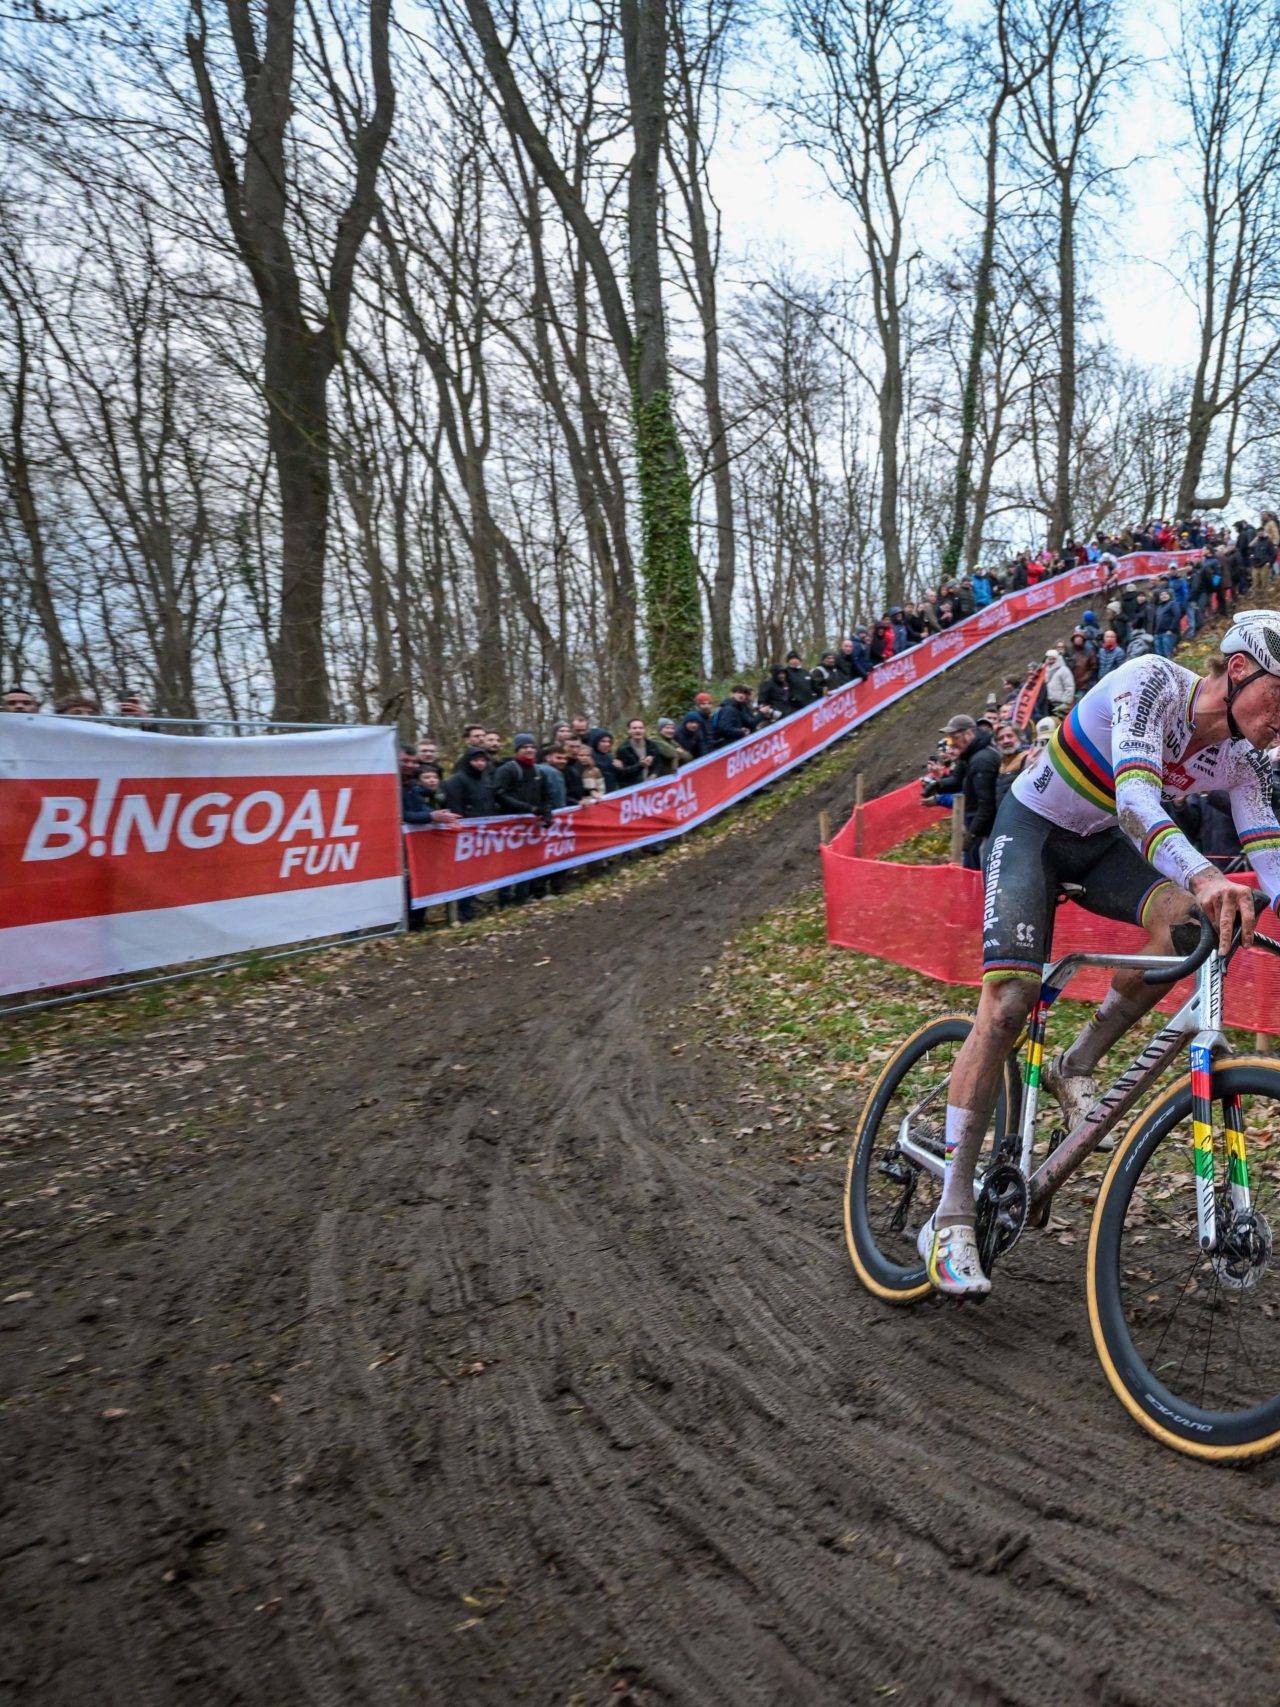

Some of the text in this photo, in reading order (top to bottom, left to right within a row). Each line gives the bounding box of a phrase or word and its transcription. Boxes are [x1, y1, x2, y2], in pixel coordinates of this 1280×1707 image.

[279, 841, 360, 878] FUN
[544, 837, 575, 860] FUN
[983, 834, 1013, 933] deceuninck
[1210, 958, 1219, 1019] CANYON
[1084, 1028, 1184, 1124] CANYON
